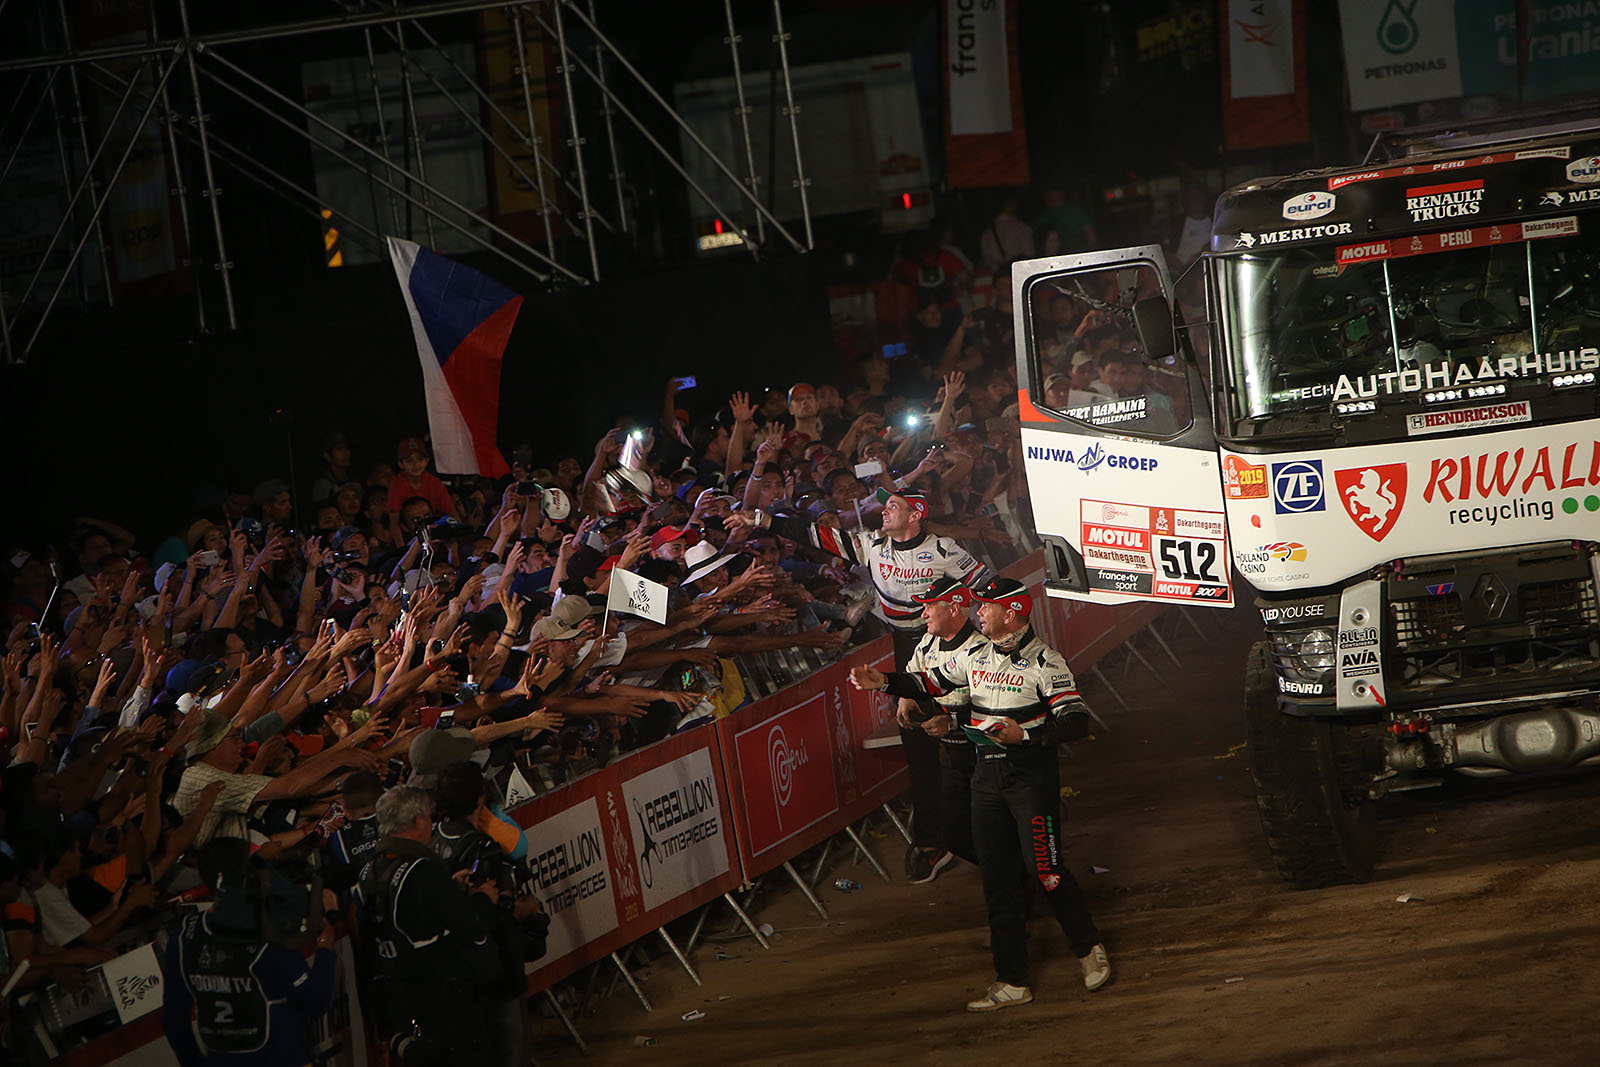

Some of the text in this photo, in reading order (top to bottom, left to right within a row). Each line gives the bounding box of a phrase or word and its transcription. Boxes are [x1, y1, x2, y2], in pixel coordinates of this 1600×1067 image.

[1494, 0, 1600, 31] PERONA
[1364, 58, 1447, 79] PETRONAS
[1332, 172, 1380, 186] MOTUL
[1287, 198, 1332, 215] eurol
[1406, 189, 1485, 211] RENAULT
[1410, 201, 1480, 222] TRUCKS
[1260, 222, 1352, 245] MERITOR
[1440, 229, 1473, 248] PERÚ
[1341, 243, 1388, 260] MOTUL
[1425, 402, 1527, 427] HENDRICKSON
[1028, 446, 1075, 464] NIJWA
[1107, 455, 1158, 471] GROEP
[1239, 469, 1264, 485] 2019
[1279, 472, 1319, 503] ZF
[1449, 497, 1554, 526] recycling
[1177, 518, 1222, 530] Dakarthegame
[1088, 527, 1143, 548] MOTUL
[1088, 548, 1147, 564] Dakarthegame
[1160, 538, 1220, 582] 512
[893, 567, 934, 579] RIWALD
[1240, 563, 1266, 574] CASINO
[1285, 573, 1311, 581] CASINO
[1115, 580, 1138, 592] sport
[1157, 583, 1226, 598] MOTUL 300V
[1340, 627, 1378, 643] ALL-IN
[984, 671, 1024, 687] RIWALD
[1031, 815, 1051, 871] RIWALD
[232, 977, 253, 993] TV
[213, 1000, 234, 1023] 2
